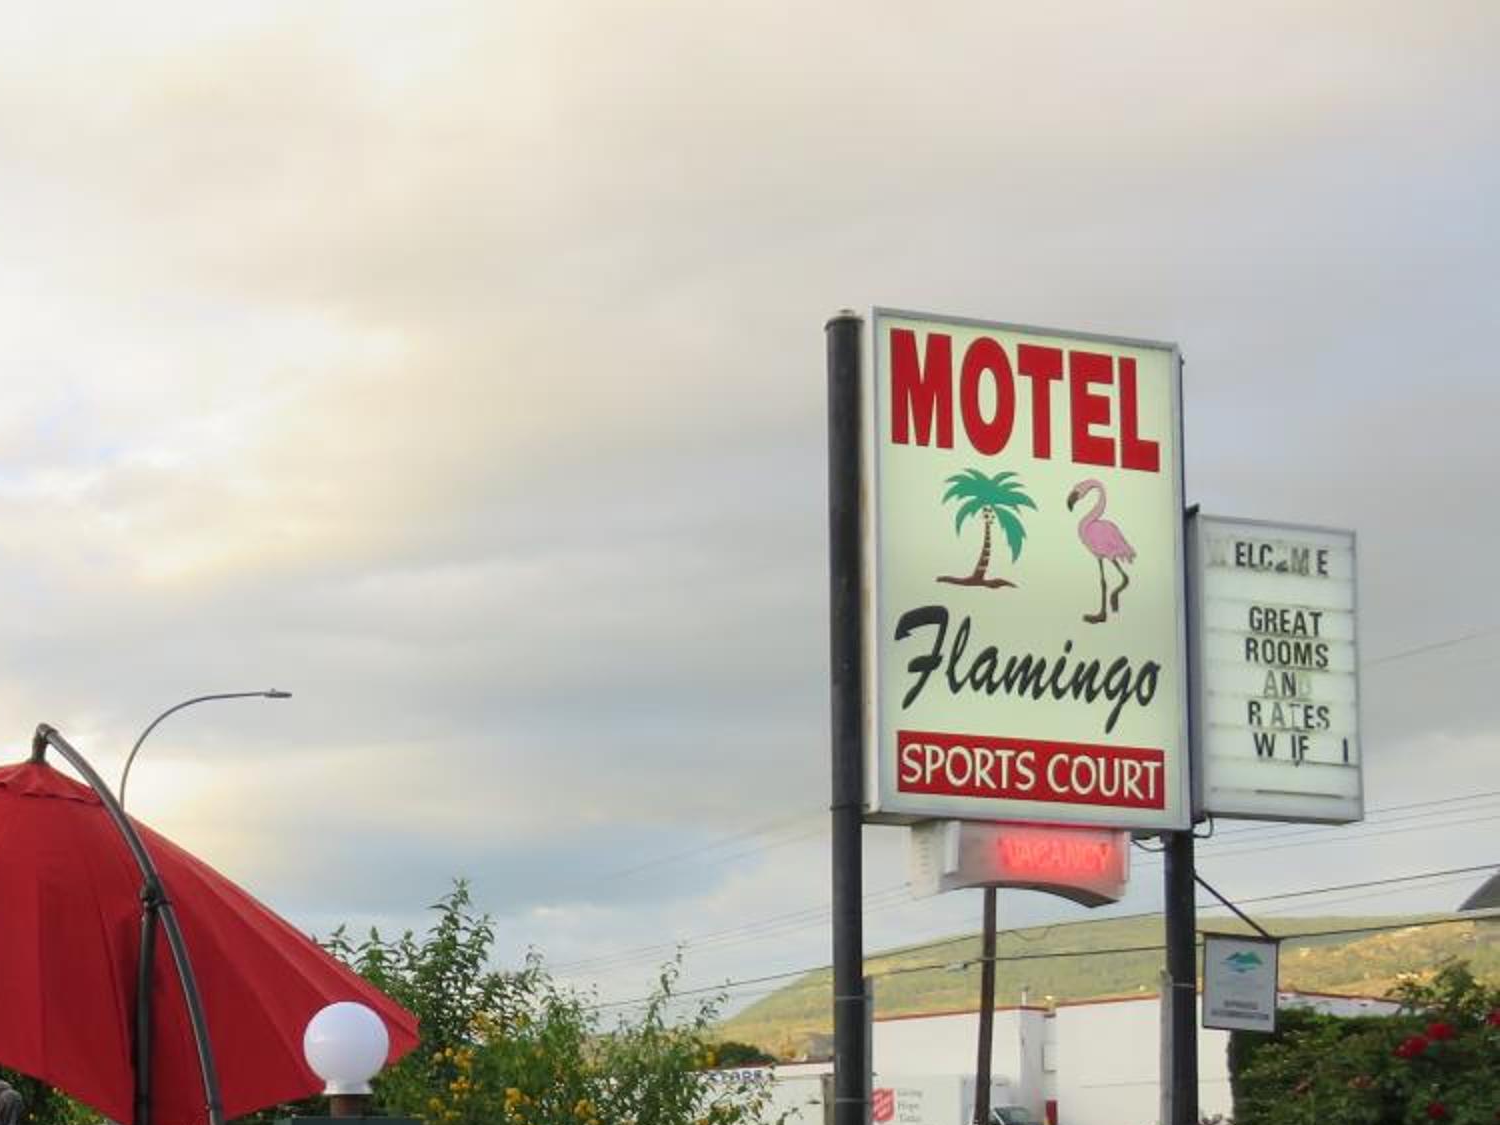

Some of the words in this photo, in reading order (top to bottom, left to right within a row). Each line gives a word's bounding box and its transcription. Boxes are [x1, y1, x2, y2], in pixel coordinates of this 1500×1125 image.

[889, 327, 1161, 473] MOTEL
[1249, 606, 1324, 637] GREAT
[894, 605, 1161, 734] Flamingo
[1245, 637, 1329, 669] ROOMS
[901, 742, 1037, 792] SPORTS
[1046, 752, 1163, 801] COURT
